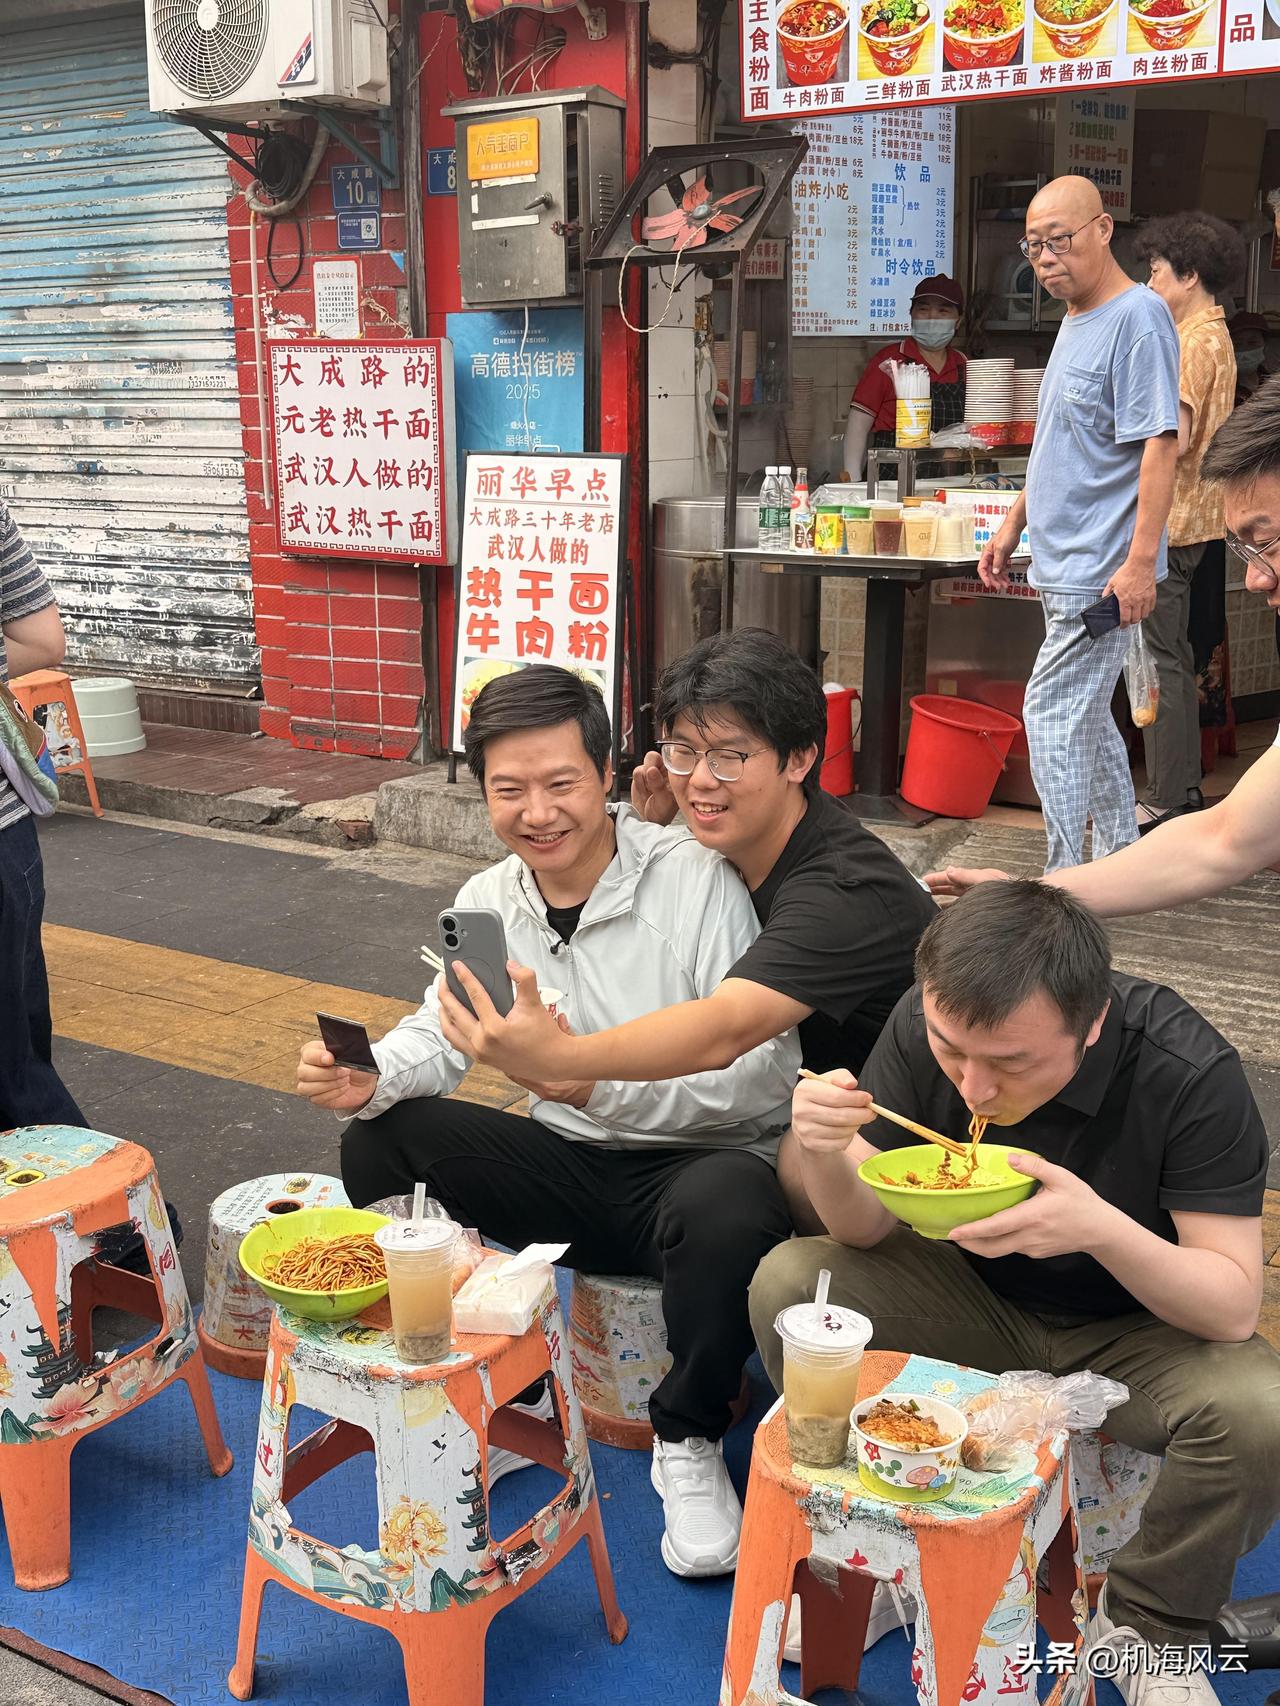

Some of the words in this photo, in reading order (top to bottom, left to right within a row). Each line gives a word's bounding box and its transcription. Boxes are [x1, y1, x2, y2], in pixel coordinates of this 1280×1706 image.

[1040, 60, 1112, 84] 炸酱粉面
[1133, 52, 1208, 77] 肉丝粉面
[865, 79, 931, 102] 三鲜粉面
[941, 67, 1028, 92] 武汉热干面
[782, 87, 845, 109] 牛肉粉面
[336, 167, 373, 180] 大成路
[895, 163, 931, 183] 饮品
[346, 181, 363, 204] 10
[795, 180, 848, 200] 油炸小吃
[886, 258, 936, 276] 时令饮品
[279, 354, 430, 389] 大成路的
[470, 350, 576, 378] 高德扫街榜
[506, 384, 541, 400] 2025
[280, 405, 431, 440] 元老热干面
[284, 452, 433, 491] 武汉人做的
[476, 465, 609, 502] 丽华早点
[286, 502, 434, 542] 武汉热干面
[468, 506, 615, 535] 大成路三十年老店
[487, 533, 589, 566] 武汉人做的
[466, 566, 609, 615] 热干面
[466, 612, 610, 662] 牛肉粉
